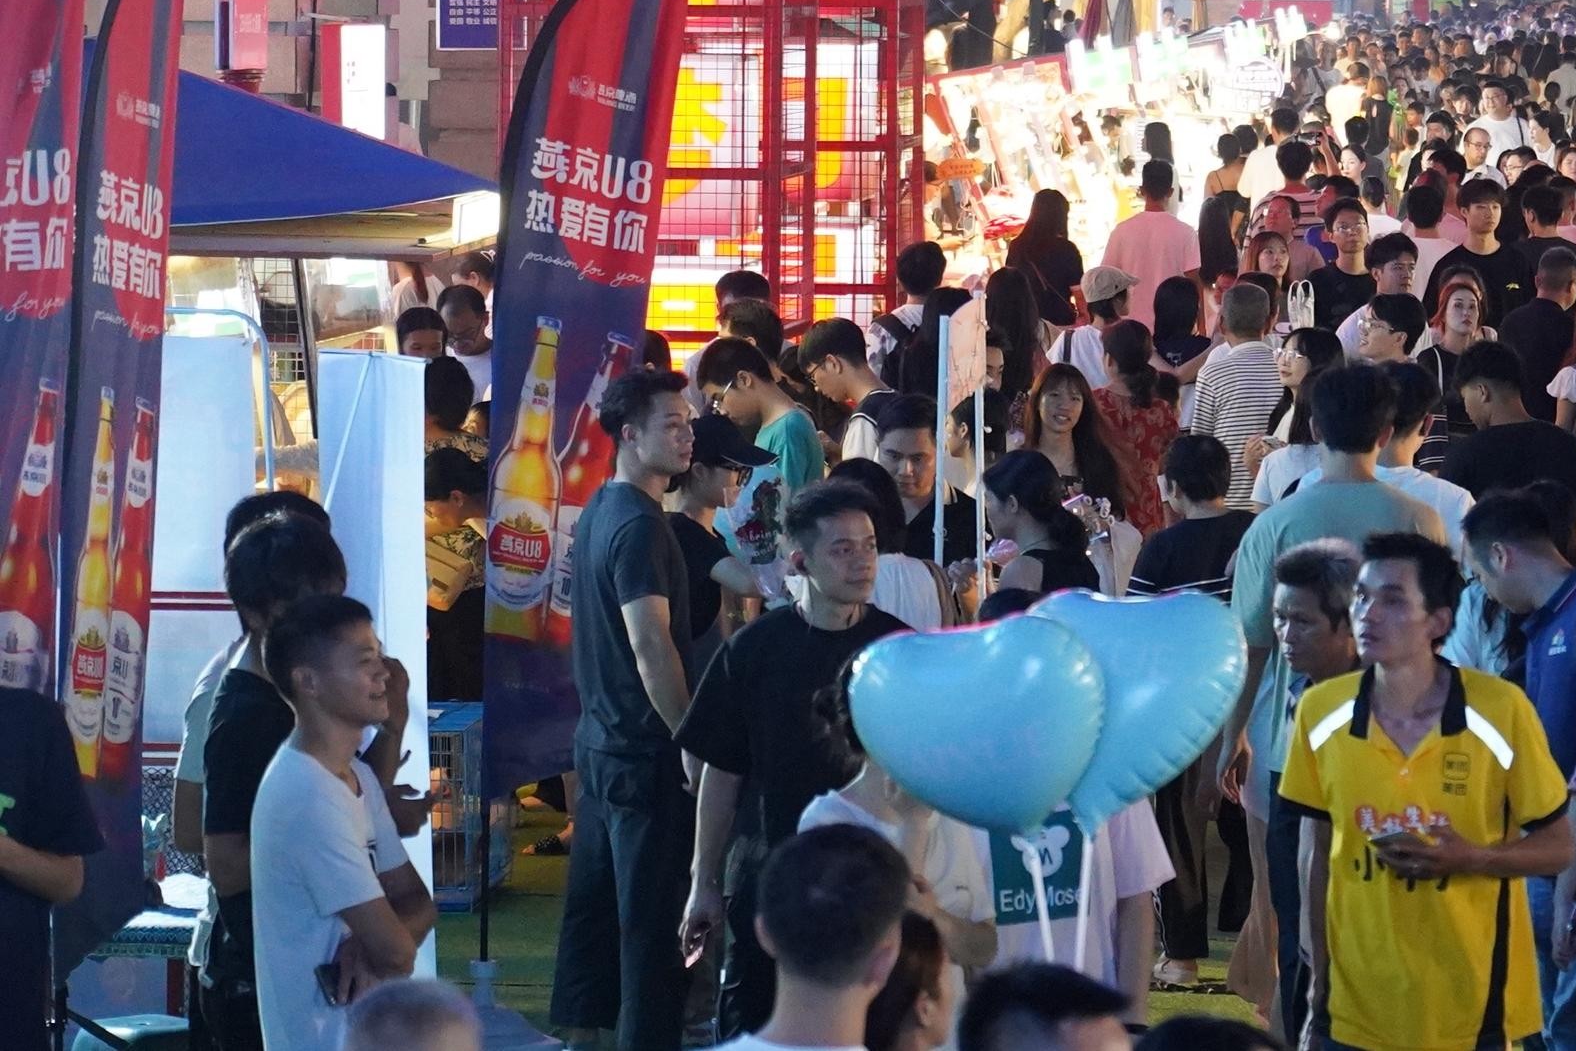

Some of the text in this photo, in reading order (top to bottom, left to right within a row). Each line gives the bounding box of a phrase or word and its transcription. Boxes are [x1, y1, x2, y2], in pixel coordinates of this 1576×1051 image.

[530, 137, 653, 204] 燕京U8
[96, 170, 164, 240] 燕京U8
[524, 189, 648, 253] 热爱有你
